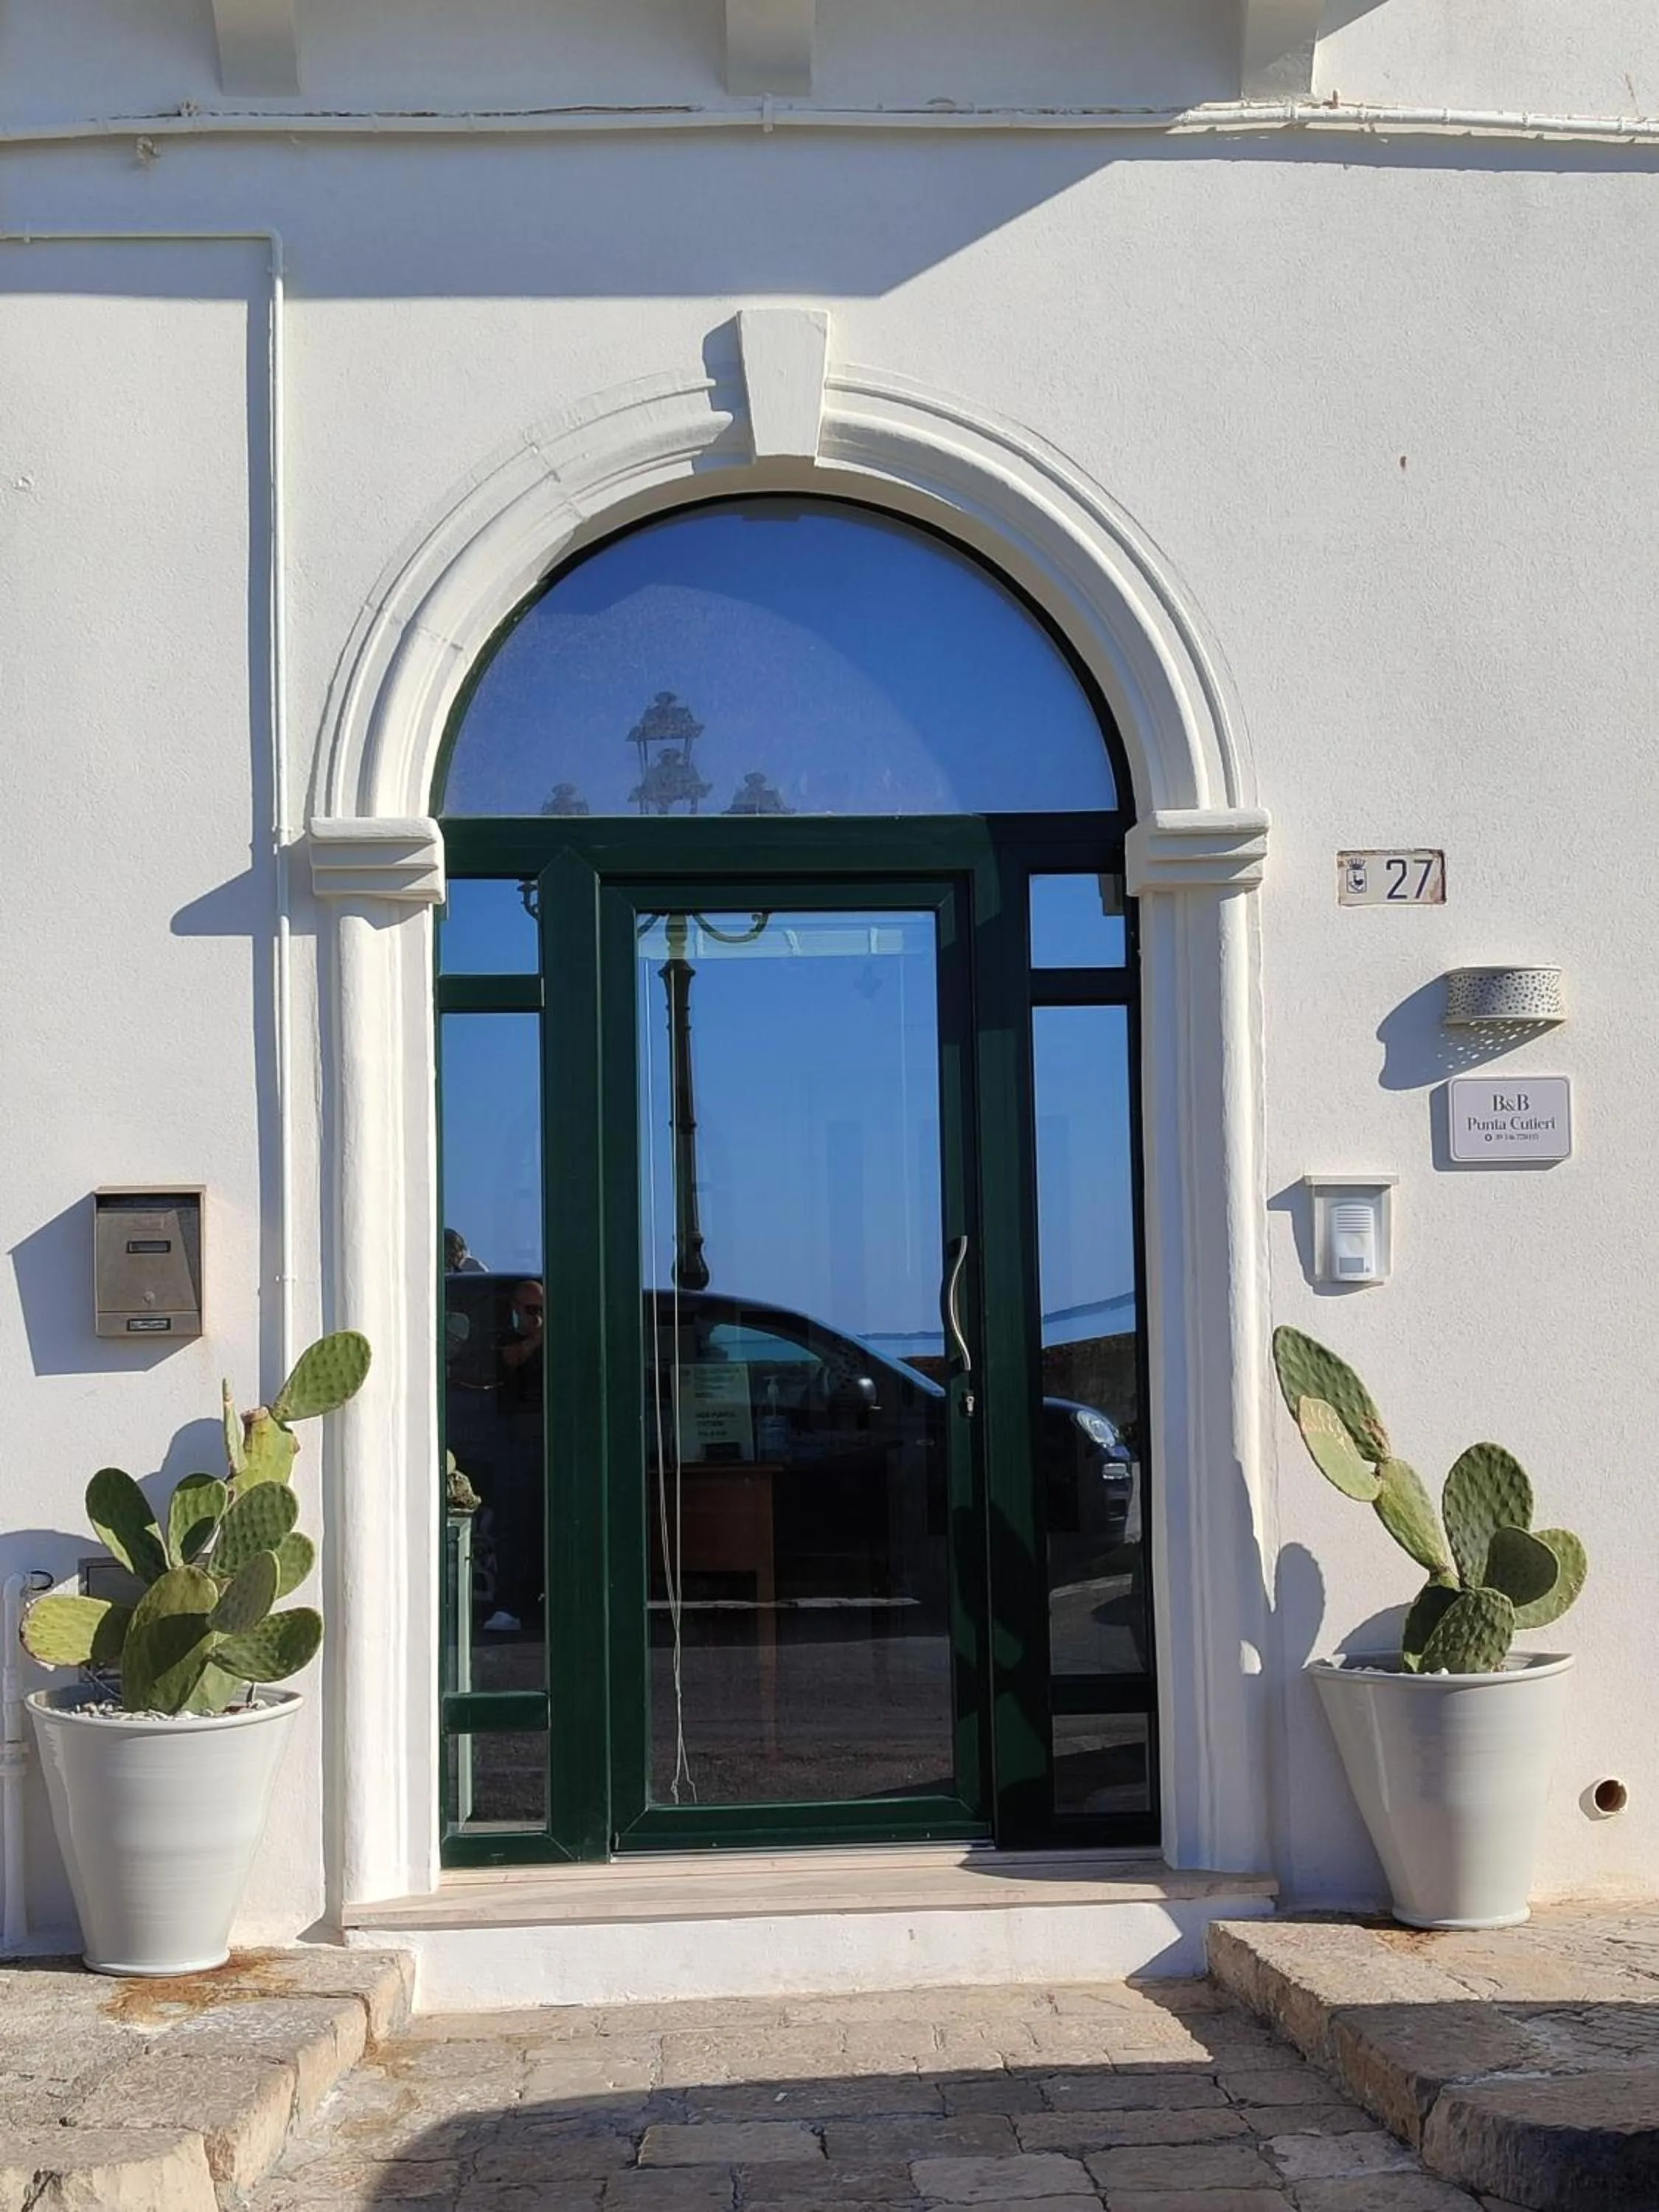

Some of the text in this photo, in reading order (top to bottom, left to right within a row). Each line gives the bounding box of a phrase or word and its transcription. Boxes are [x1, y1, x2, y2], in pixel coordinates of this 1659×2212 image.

[1385, 859, 1434, 900] 27
[1492, 1093, 1530, 1112] B&B
[1467, 1116, 1556, 1131] Punta Cutieri
